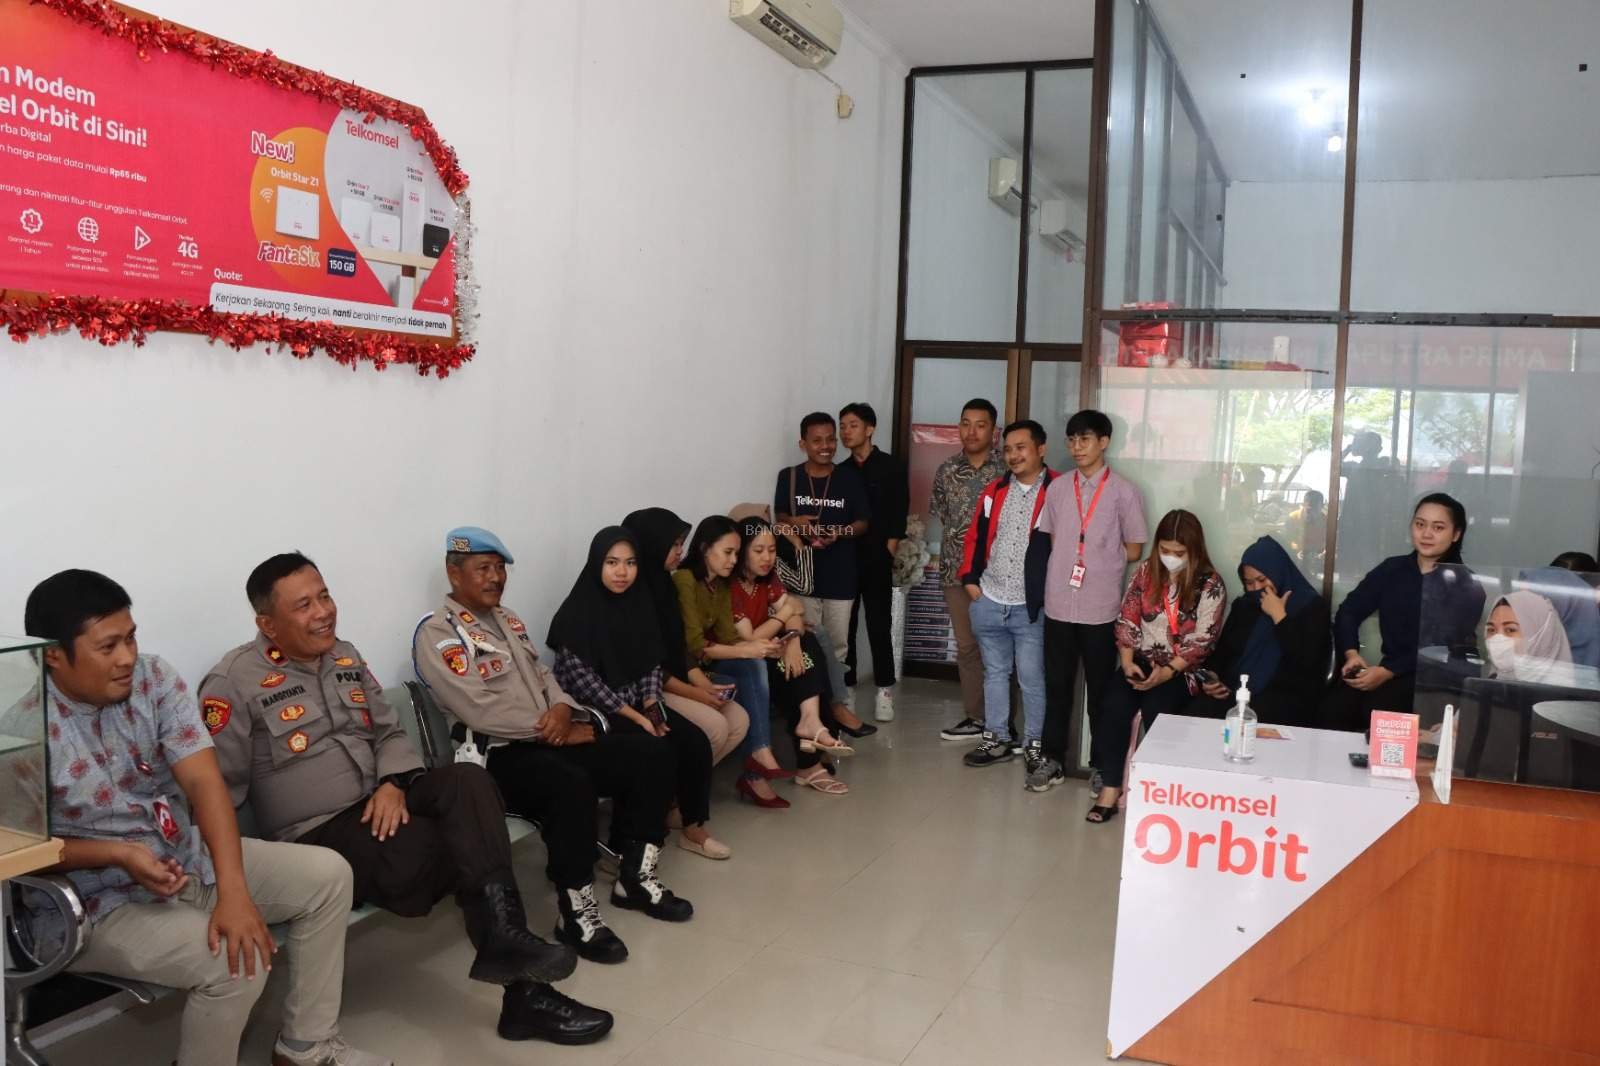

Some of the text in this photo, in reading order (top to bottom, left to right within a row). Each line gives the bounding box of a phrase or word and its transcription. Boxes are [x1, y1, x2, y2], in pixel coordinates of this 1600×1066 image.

[16, 65, 95, 107] Modem
[20, 127, 51, 143] Digital
[22, 98, 79, 131] Orbit
[83, 115, 102, 137] di
[106, 121, 147, 148] Sini!
[345, 119, 399, 150] Telkomsel
[251, 130, 296, 164] New!
[7, 144, 35, 159] harga
[37, 152, 62, 164] paket
[63, 157, 84, 170] data
[85, 163, 108, 175] mulai
[131, 172, 147, 183] ribu
[271, 167, 291, 180] Orbit
[292, 172, 308, 184] Star
[23, 187, 40, 198] dan
[41, 191, 70, 203] nikmati
[177, 241, 199, 259] 4G
[214, 267, 243, 281] Quote:
[329, 259, 355, 273] 150 GB
[216, 293, 252, 307] Kerjakan
[293, 302, 316, 316] Sering
[332, 308, 351, 318] nanti
[408, 317, 424, 328] tidak
[425, 320, 447, 331] pernah
[795, 495, 845, 509] Telkomsel
[1139, 780, 1277, 817] Telkomsel
[1135, 813, 1309, 883] Orbit
